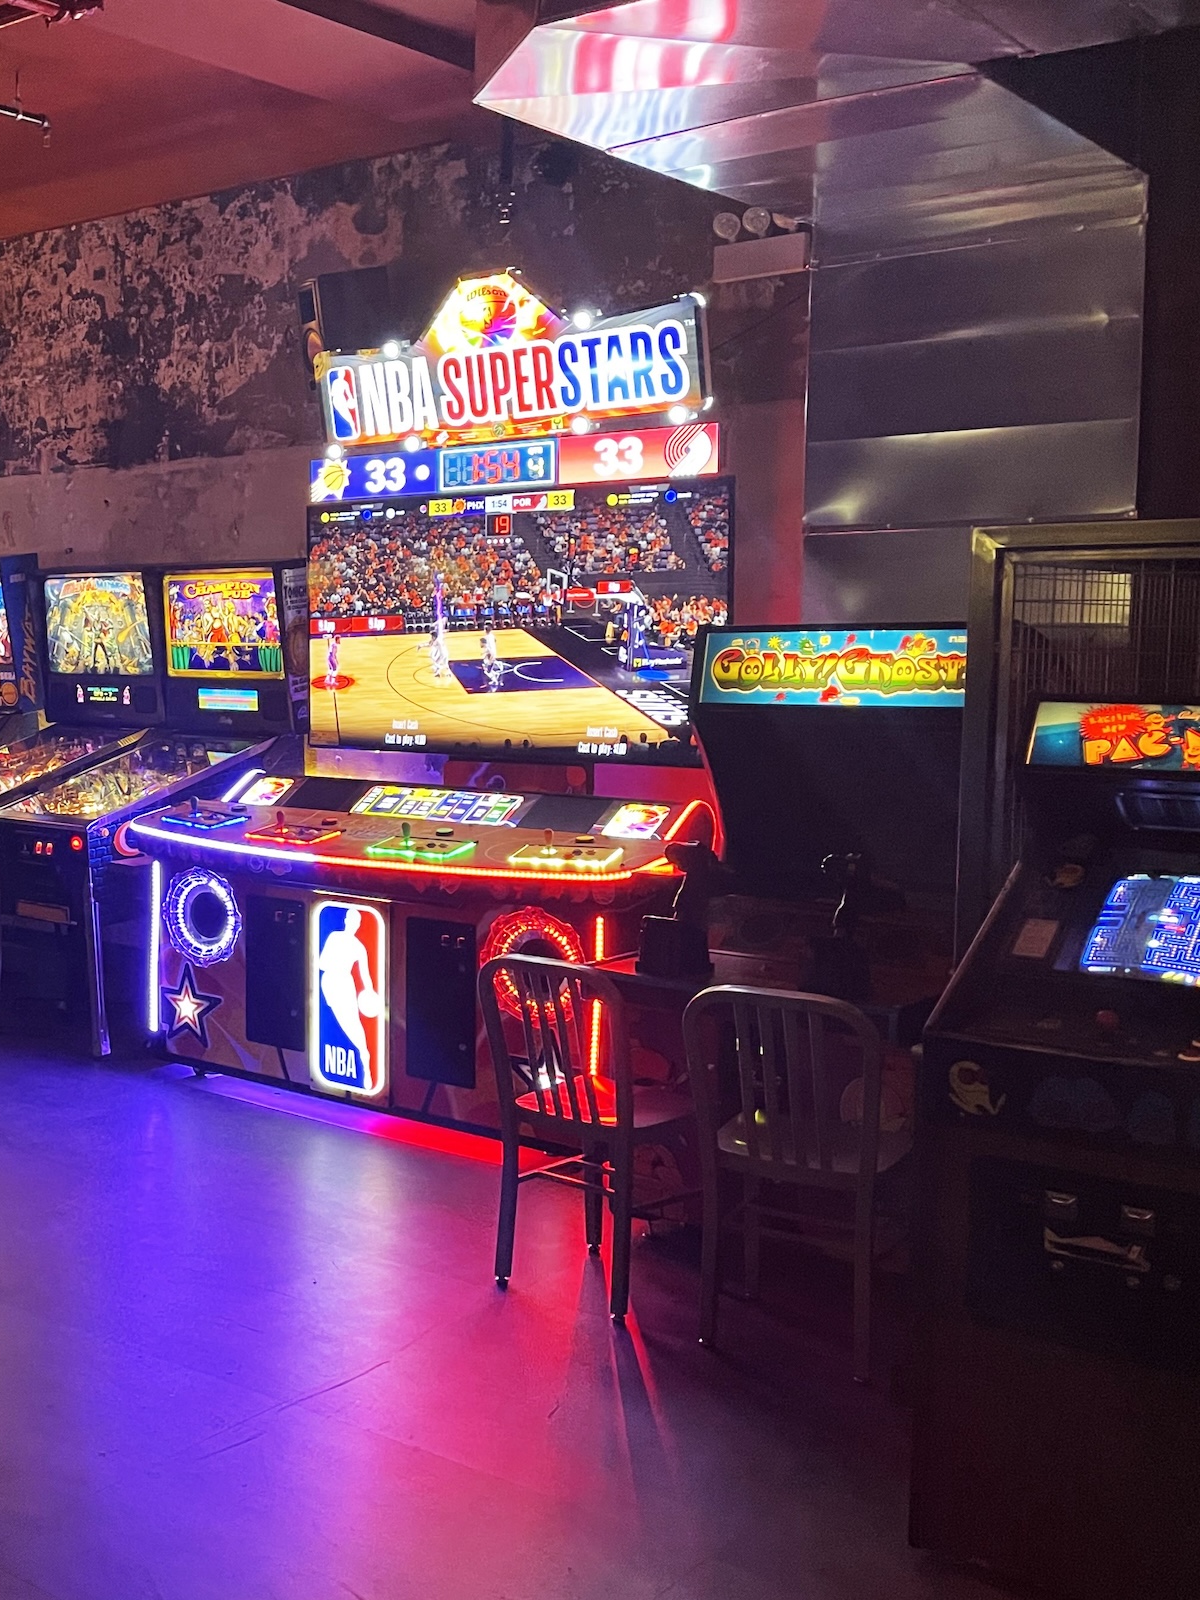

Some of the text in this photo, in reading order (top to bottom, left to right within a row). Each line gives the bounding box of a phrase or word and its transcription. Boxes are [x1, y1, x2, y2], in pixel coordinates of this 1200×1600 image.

[360, 356, 440, 437] NBA
[471, 448, 520, 483] 1:54
[593, 437, 644, 476] 33
[365, 457, 407, 494] 33
[434, 500, 485, 513] 33 PHX
[492, 499, 508, 509] 1:54
[513, 495, 568, 508] POR 33
[493, 515, 510, 534] 19
[183, 582, 261, 599] CHAMPION
[223, 589, 256, 599] PUB
[712, 648, 840, 691] GOLLY!
[324, 1043, 358, 1080] NBA
